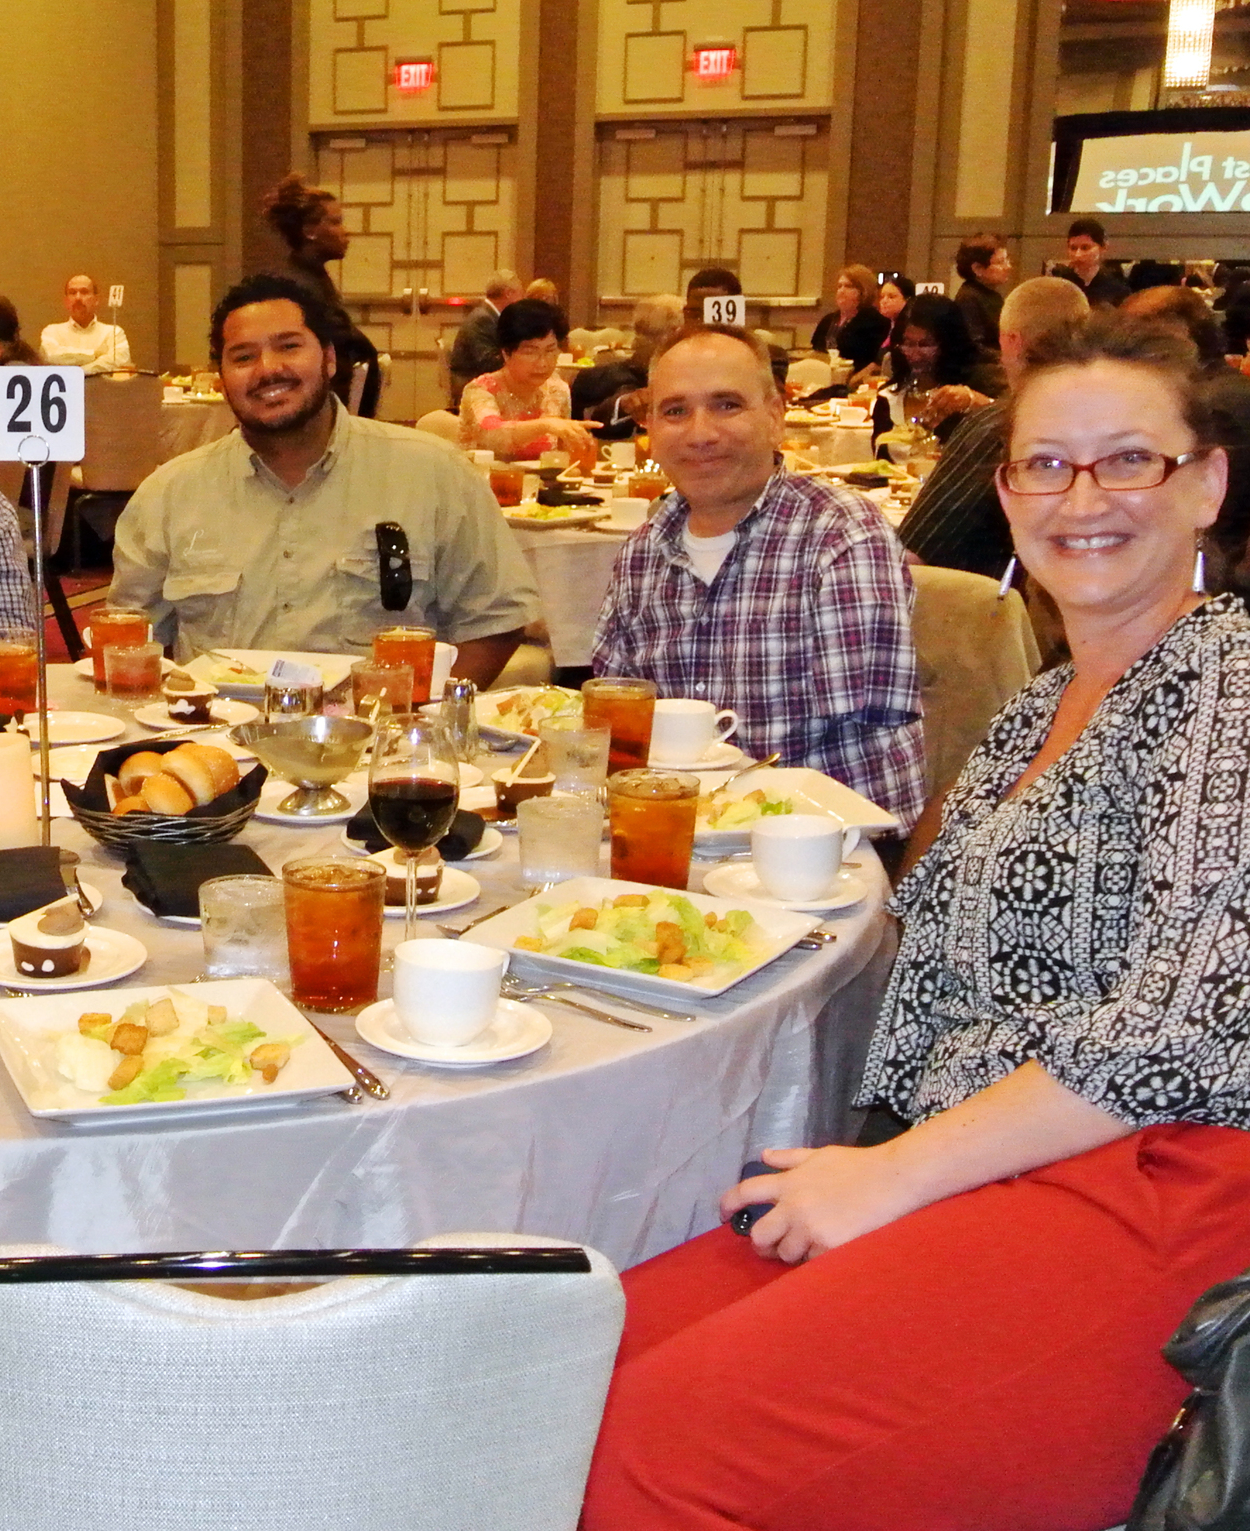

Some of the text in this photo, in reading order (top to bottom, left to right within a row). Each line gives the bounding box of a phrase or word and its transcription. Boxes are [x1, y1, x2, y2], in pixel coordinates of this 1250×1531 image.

[700, 50, 730, 74] EXIT
[401, 64, 428, 87] EXIT
[712, 299, 737, 323] 39
[6, 373, 67, 434] 26
